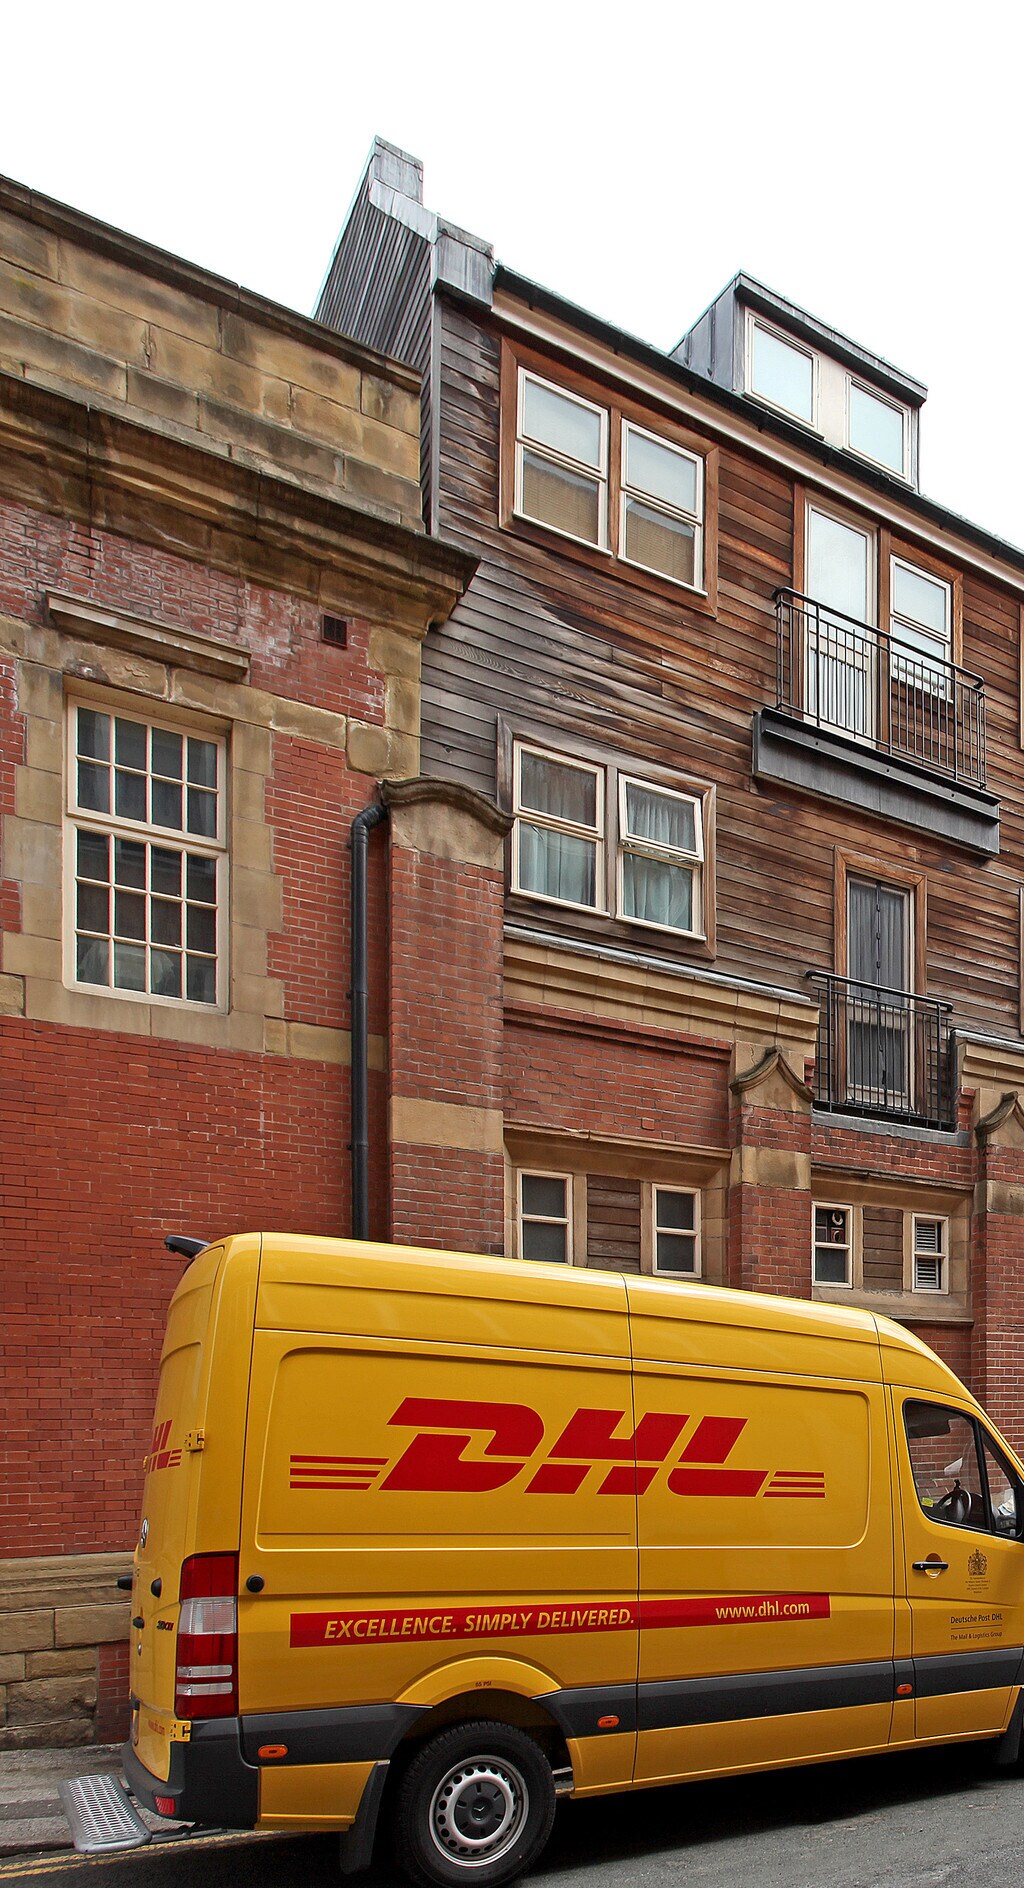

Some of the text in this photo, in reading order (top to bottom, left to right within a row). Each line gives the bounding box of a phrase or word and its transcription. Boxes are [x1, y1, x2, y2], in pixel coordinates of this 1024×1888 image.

[378, 1397, 769, 1497] DHL
[715, 1600, 810, 1619] www.dhl.com
[950, 1613, 1003, 1624] Deutsche Post DHL
[324, 1608, 635, 1639] EXCELLENCE. SIMPLY DELIVERED.
[972, 1632, 990, 1640] Logistics
